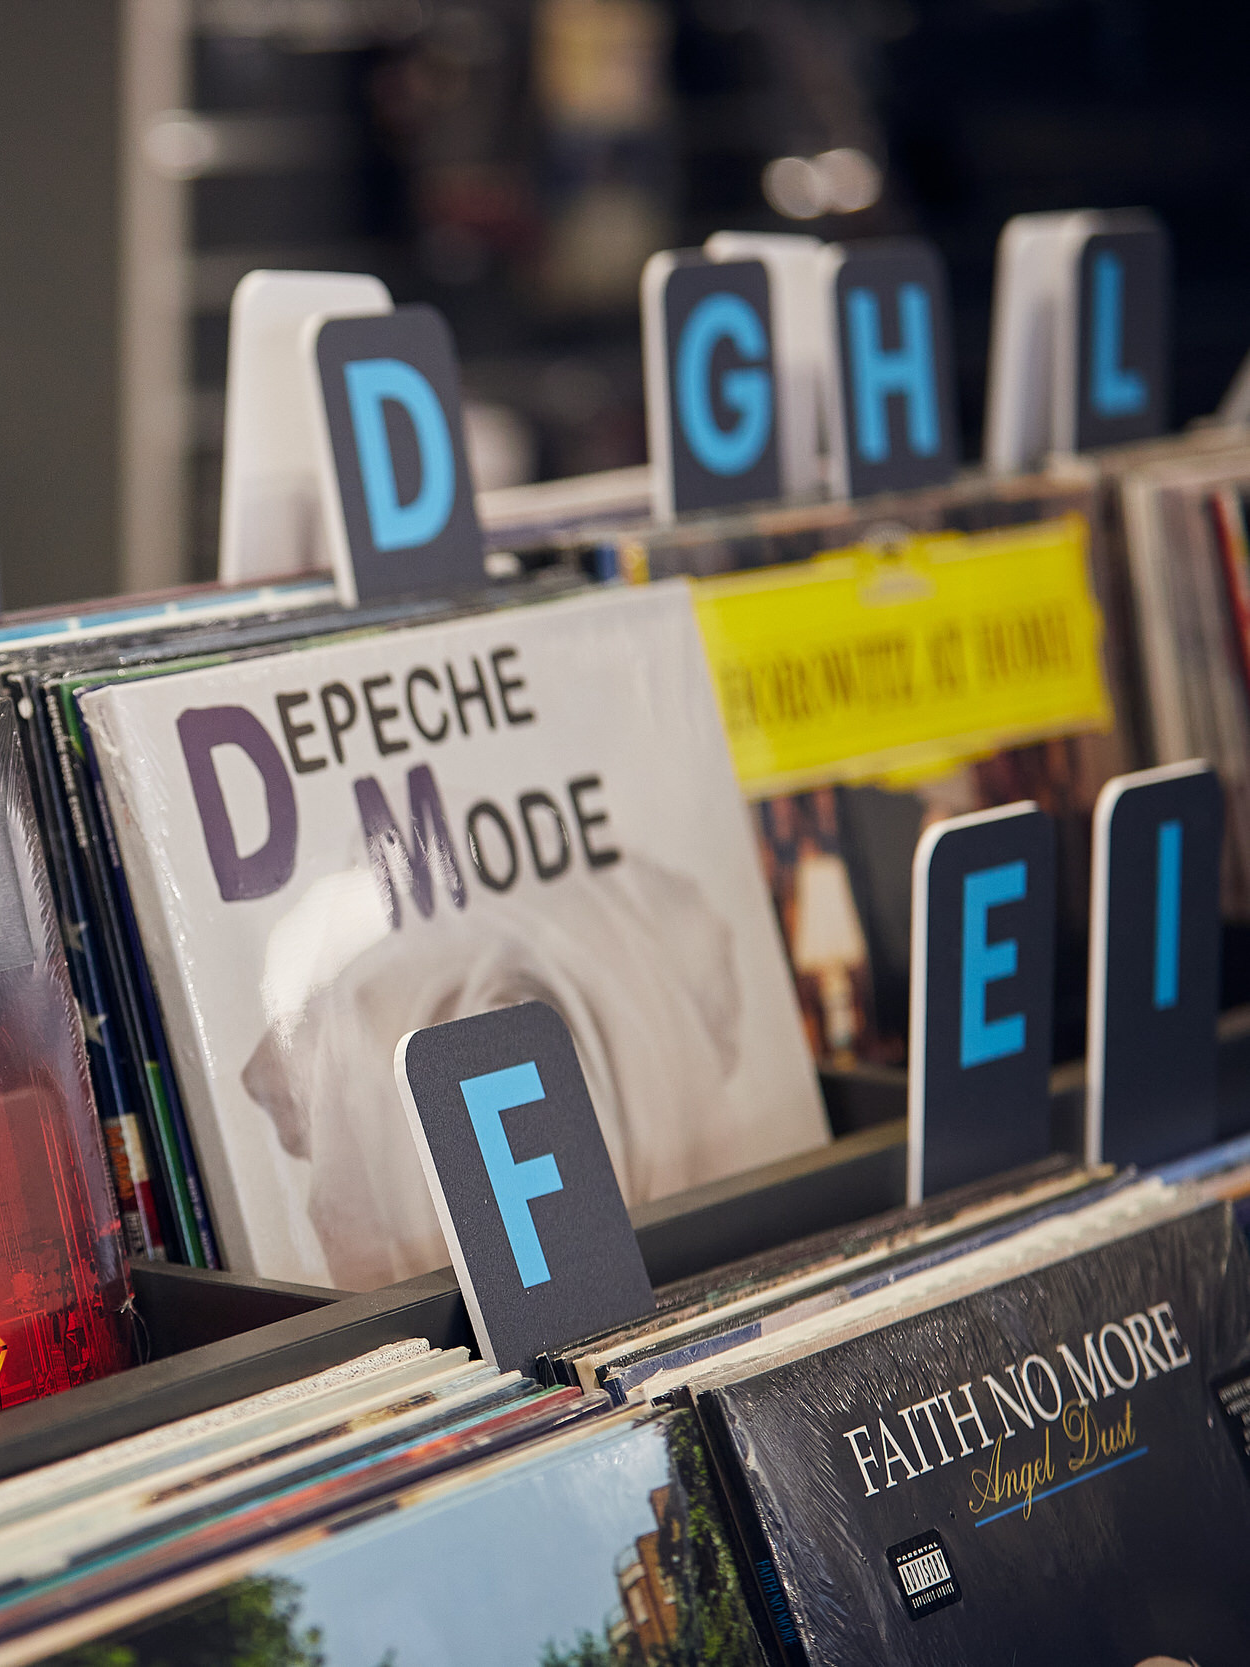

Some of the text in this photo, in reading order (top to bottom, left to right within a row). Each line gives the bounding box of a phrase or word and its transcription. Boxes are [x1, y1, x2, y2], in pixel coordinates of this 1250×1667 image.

[676, 292, 774, 476] G
[847, 283, 941, 464] H
[1092, 251, 1147, 415] L
[345, 357, 455, 551] D
[177, 647, 536, 901] DEPECHE
[354, 763, 620, 931] MODE
[960, 861, 1026, 1069] E
[460, 1062, 564, 1289] F
[843, 1302, 1191, 1498] FAITH NO MORE
[968, 1426, 1055, 1521] Angel
[1062, 1398, 1137, 1472] Dust
[755, 1559, 799, 1646] FAITH NO MORE
[896, 1541, 939, 1564] PARENTAL
[899, 1550, 949, 1593] ADVISORY
